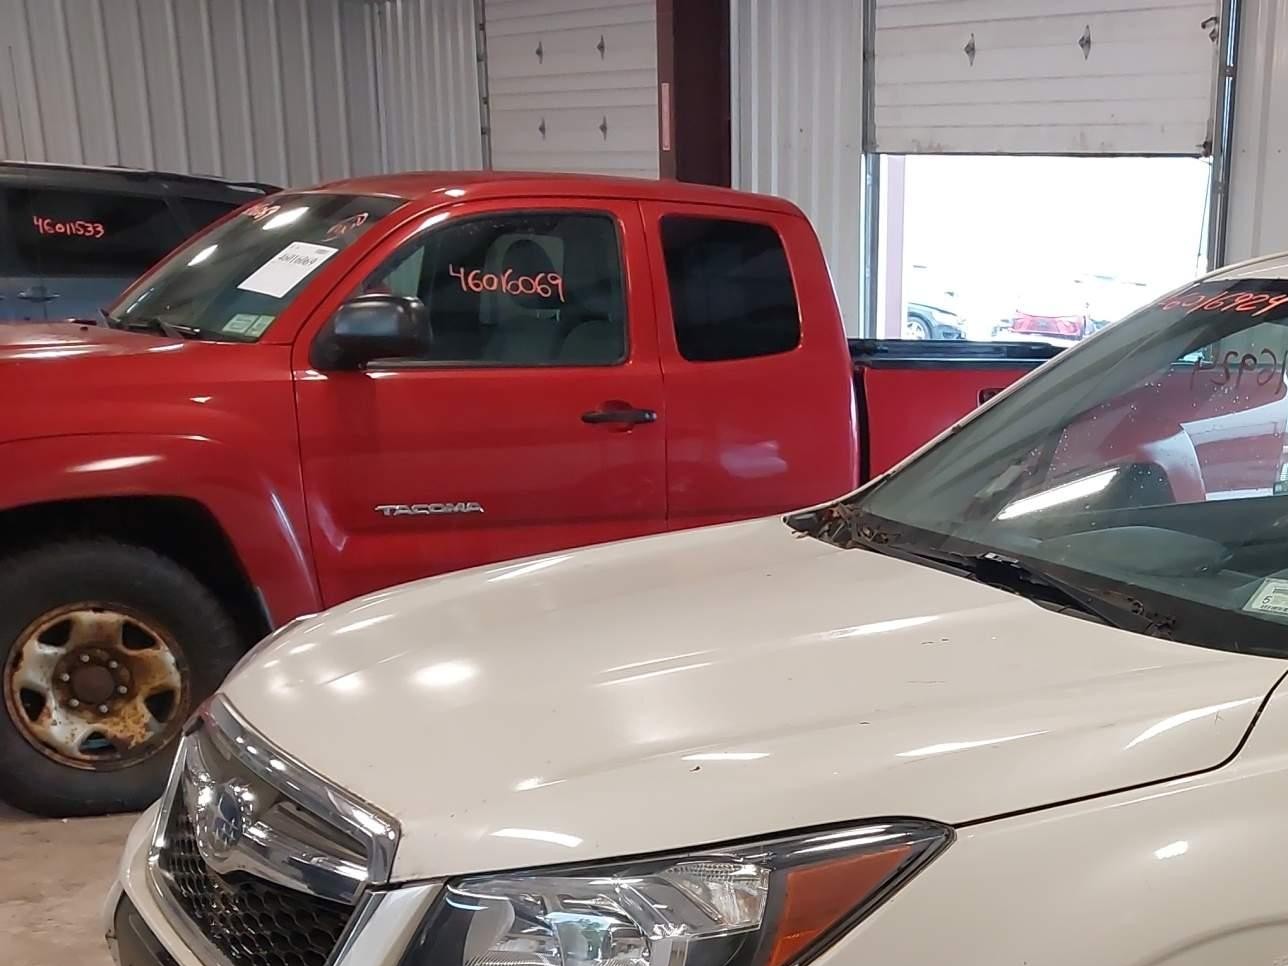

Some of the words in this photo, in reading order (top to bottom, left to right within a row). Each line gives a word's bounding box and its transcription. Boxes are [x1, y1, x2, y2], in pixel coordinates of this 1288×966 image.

[33, 215, 104, 238] 46011533
[449, 264, 565, 302] 46016069
[375, 503, 484, 516] TACOMA
